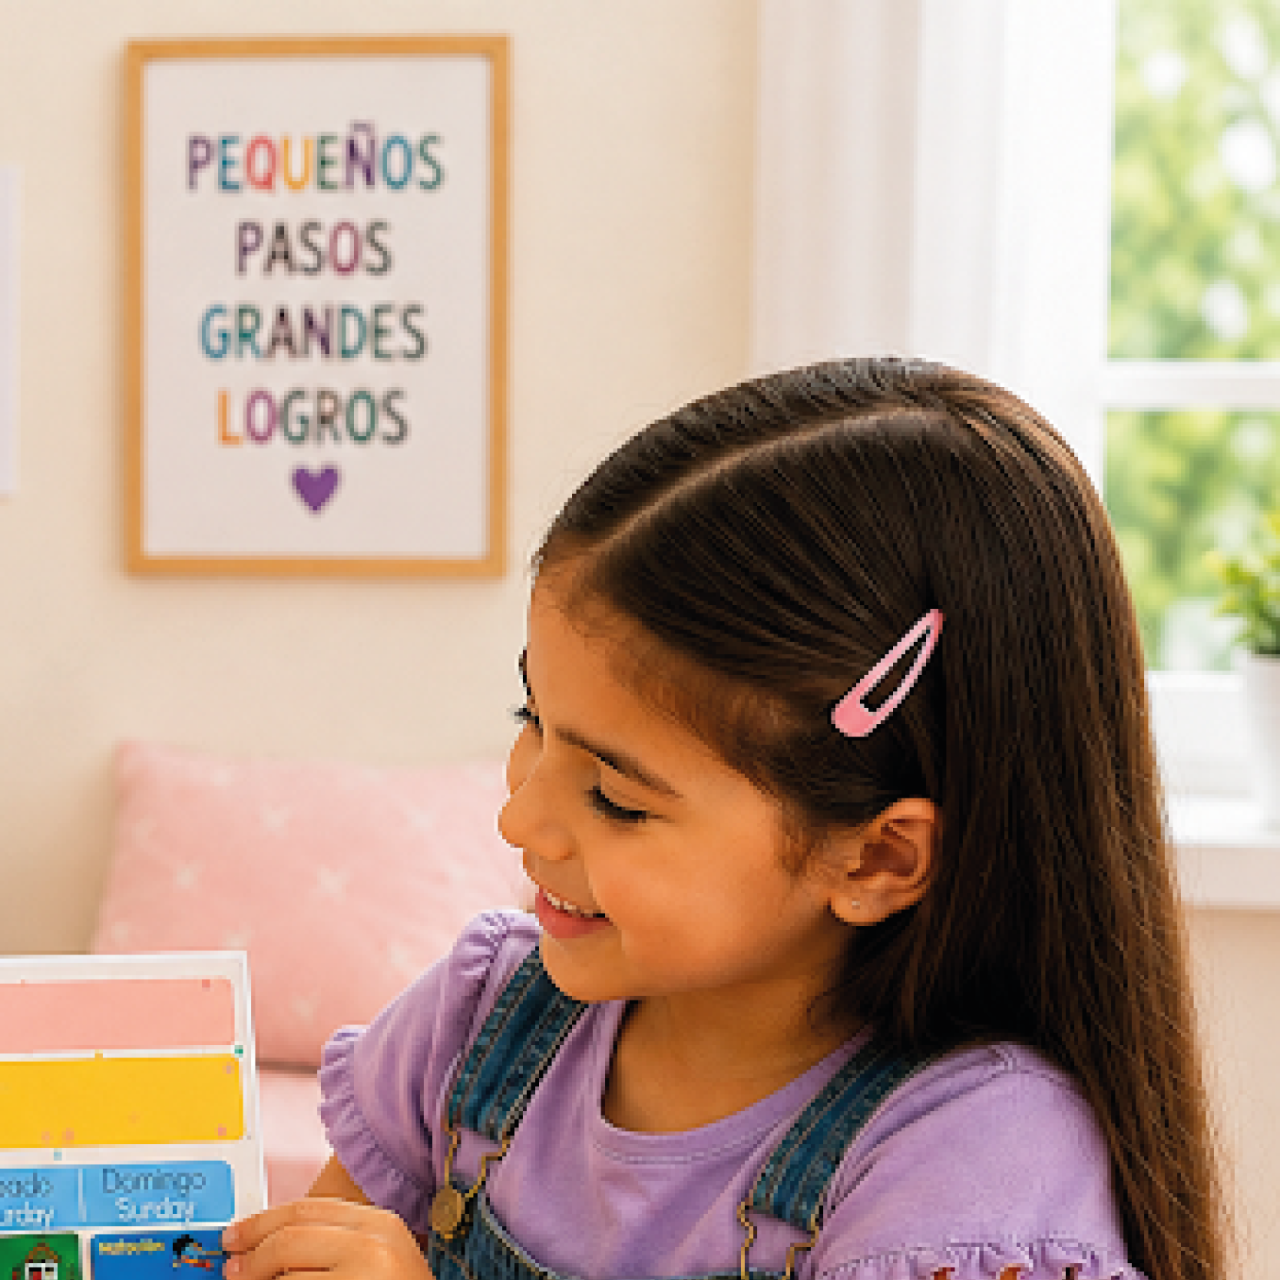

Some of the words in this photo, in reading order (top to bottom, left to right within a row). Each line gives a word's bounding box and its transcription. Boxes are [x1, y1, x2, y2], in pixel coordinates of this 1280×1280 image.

[186, 120, 445, 193] PEQUEÑOS
[237, 221, 392, 276] PASOS
[199, 305, 427, 360] GRANDES
[217, 389, 410, 446] LOGROS
[102, 1167, 207, 1198] Domingo
[114, 1197, 198, 1230] Sunday
